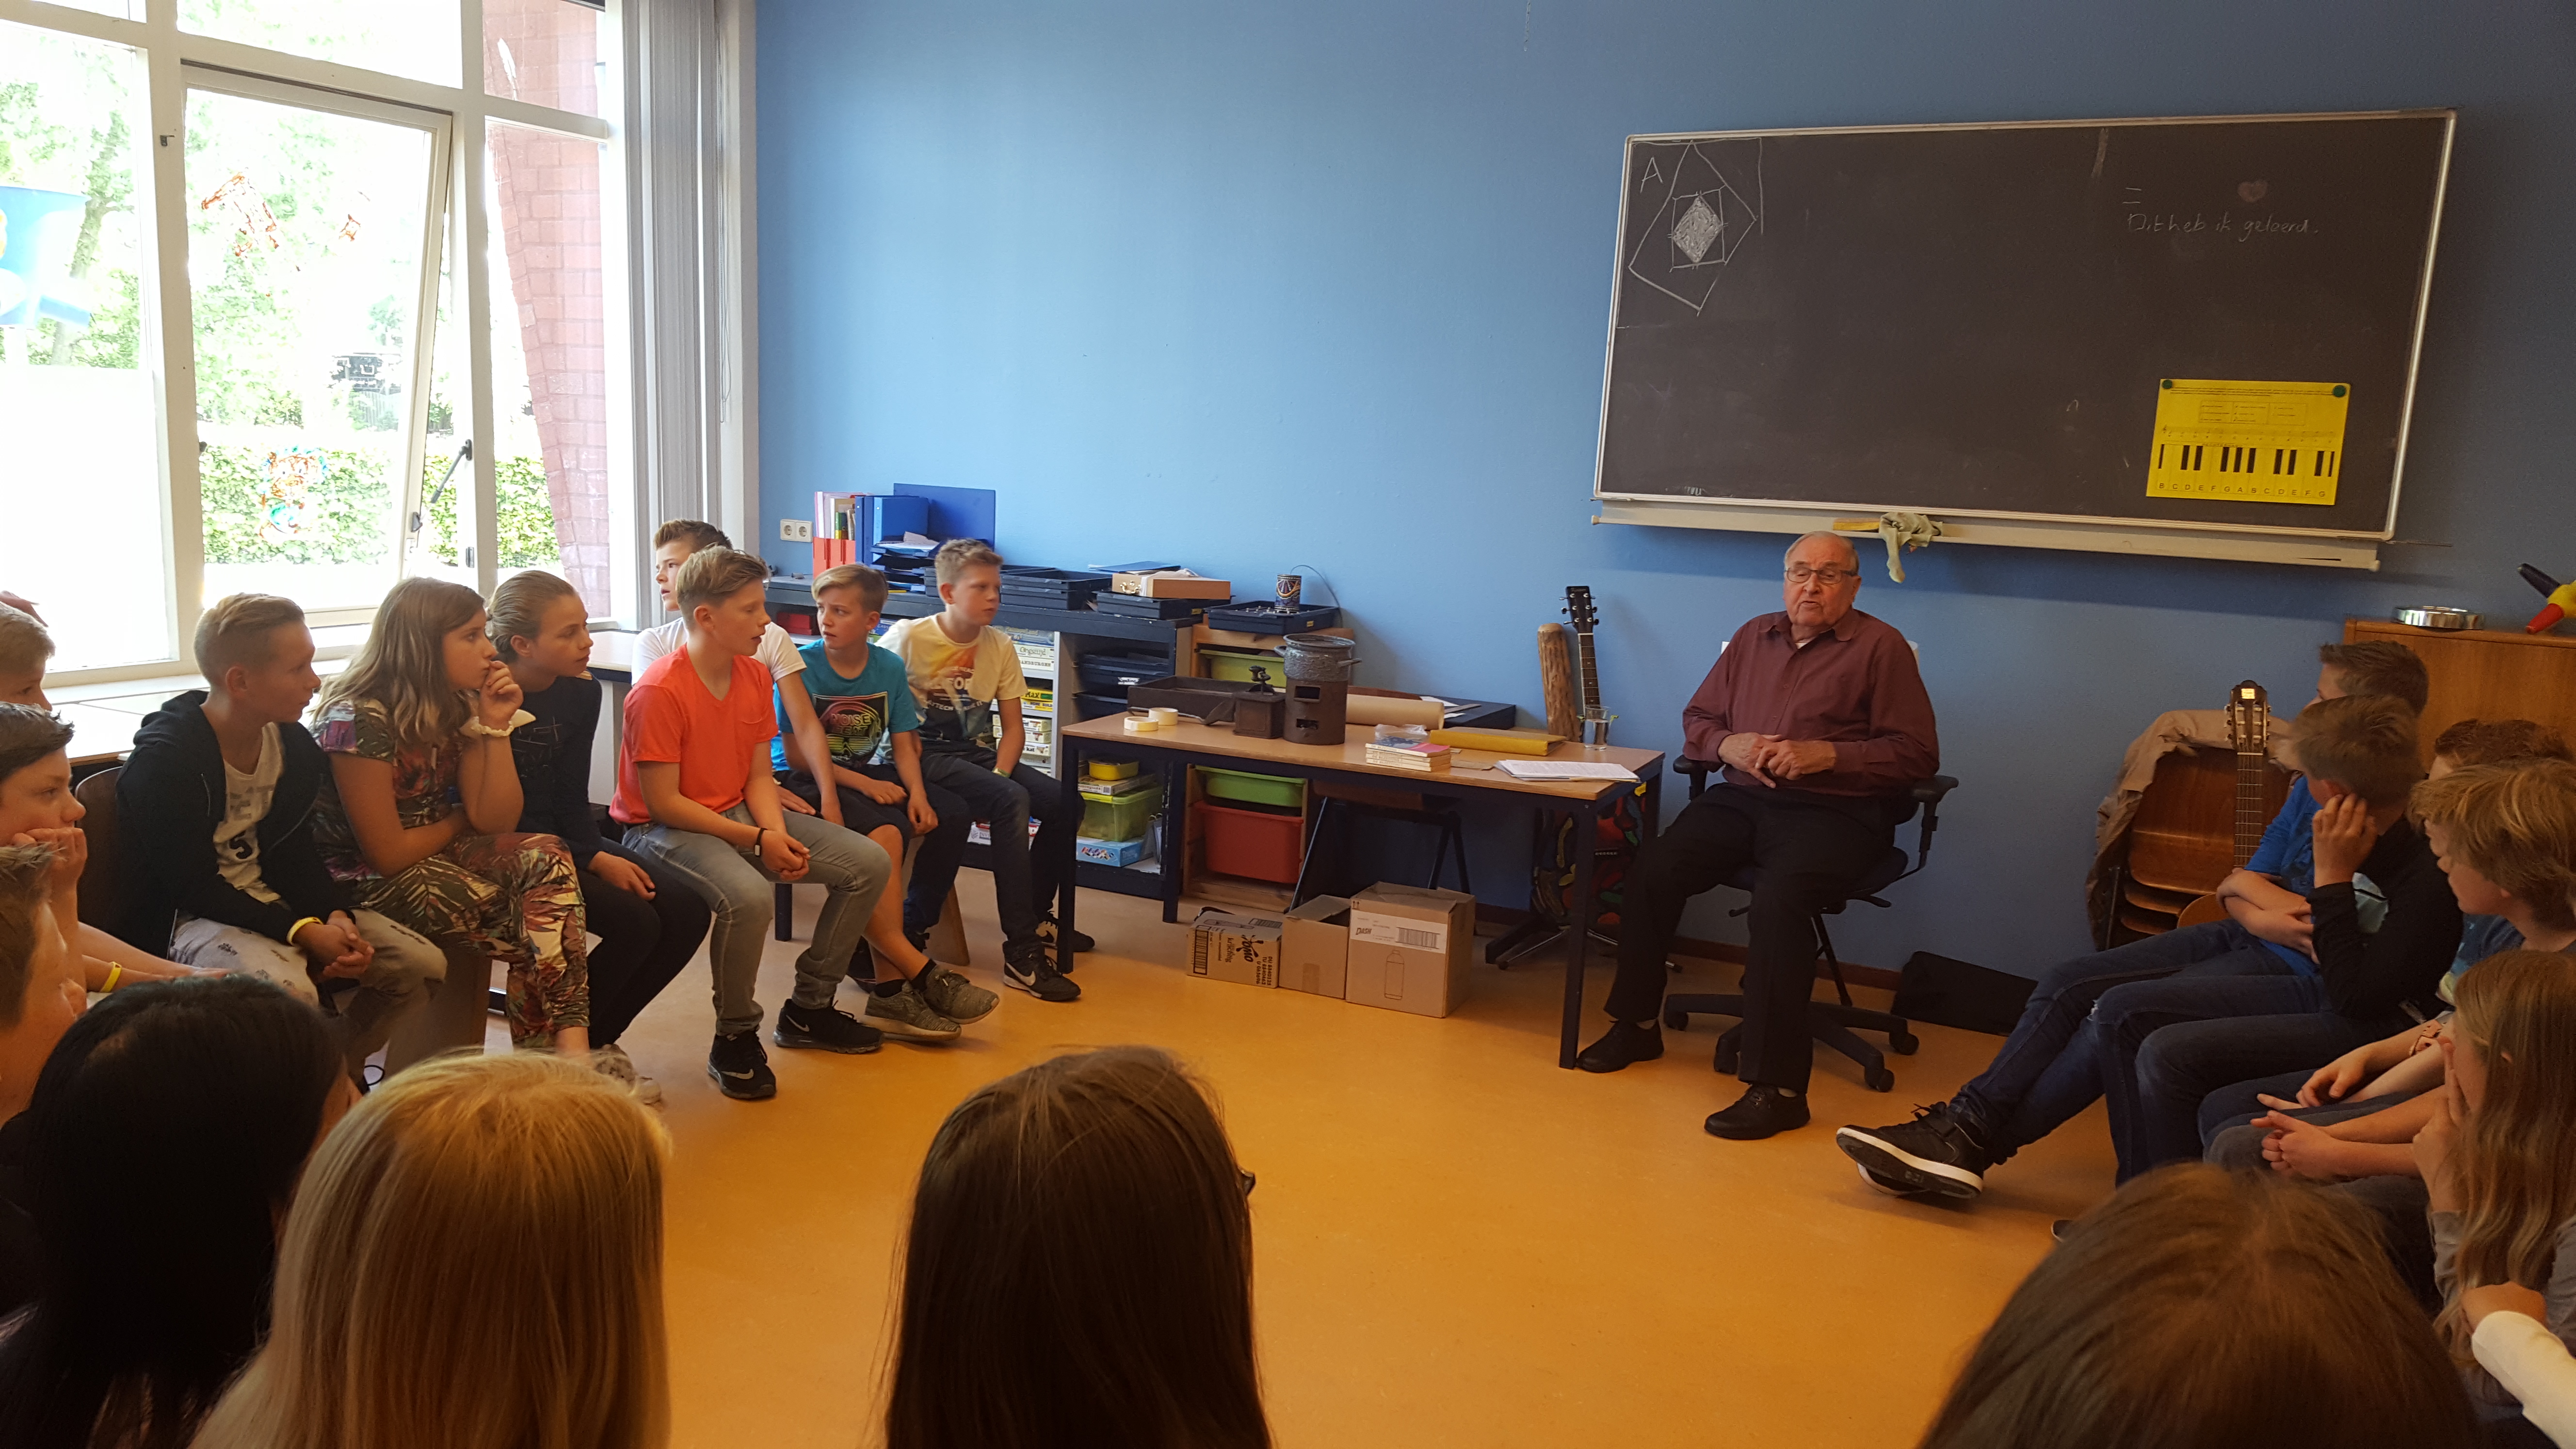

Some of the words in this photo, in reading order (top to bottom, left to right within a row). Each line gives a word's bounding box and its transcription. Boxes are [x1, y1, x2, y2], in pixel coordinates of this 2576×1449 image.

[1640, 157, 1663, 193] A
[2127, 213, 2164, 232] Dit
[2168, 213, 2206, 232] heb
[2216, 211, 2231, 231] ik
[1355, 927, 1372, 935] DASH
[1241, 941, 1254, 963] OMO
